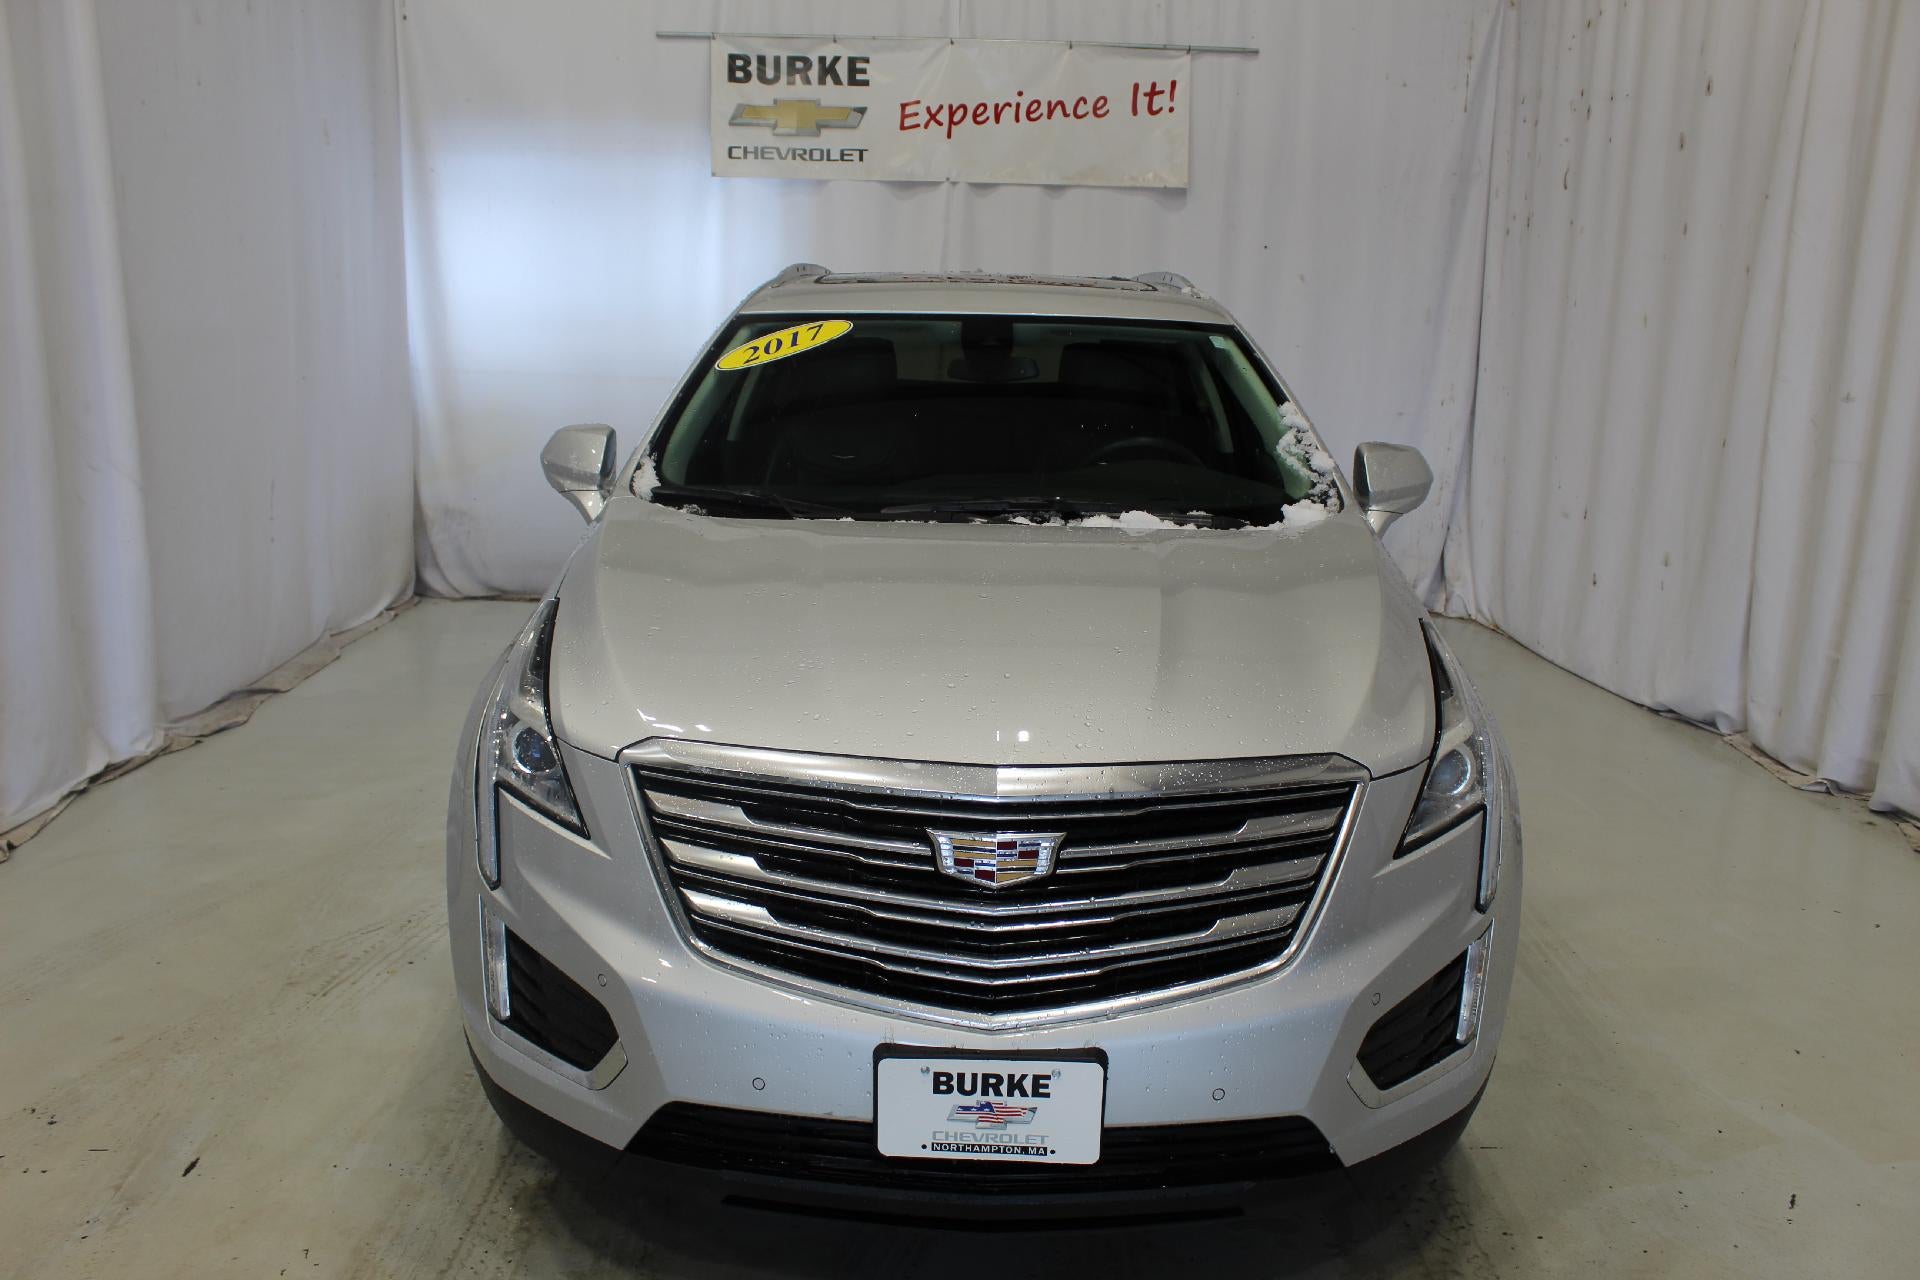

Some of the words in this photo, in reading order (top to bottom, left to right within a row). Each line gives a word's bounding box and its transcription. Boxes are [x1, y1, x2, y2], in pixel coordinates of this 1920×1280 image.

[728, 53, 870, 86] BURKE
[899, 90, 1110, 139] Experience
[1130, 79, 1177, 116] It!
[728, 145, 869, 162] CHEVROLET
[743, 323, 824, 365] 2017
[932, 1071, 1052, 1098] BURKE
[932, 1130, 1049, 1145] CHEVROLET
[1028, 1147, 1045, 1155] MA
